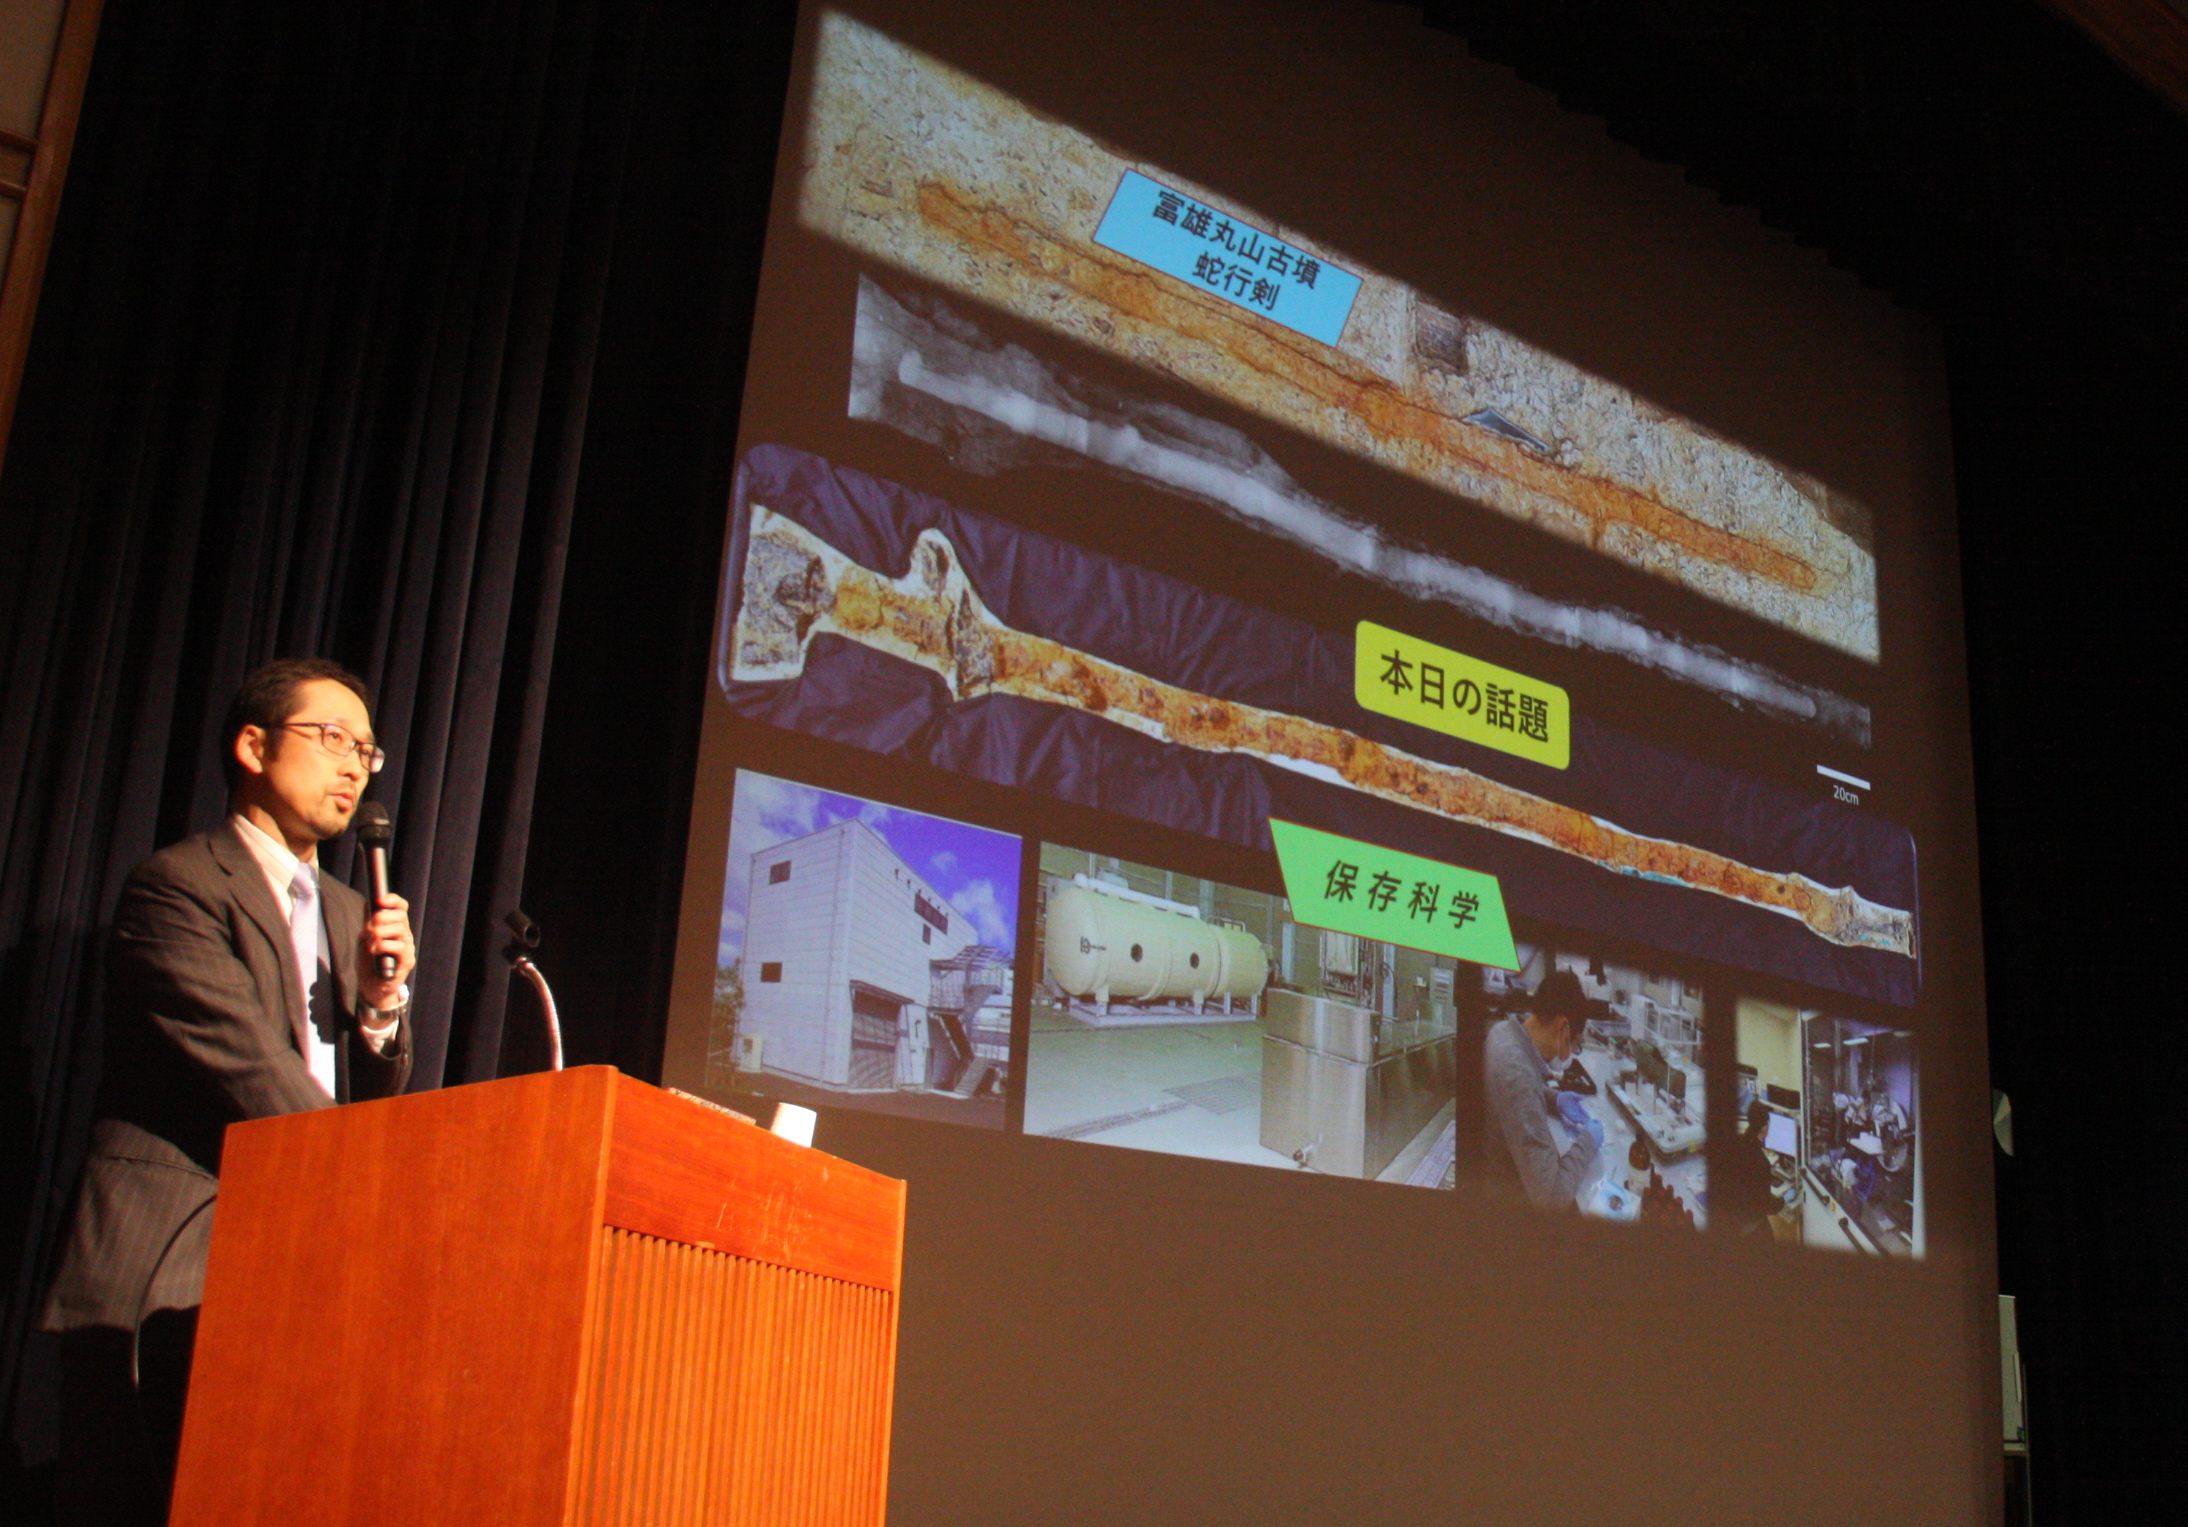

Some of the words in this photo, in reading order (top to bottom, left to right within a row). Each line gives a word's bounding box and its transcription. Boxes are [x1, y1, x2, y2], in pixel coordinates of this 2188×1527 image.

[1152, 190, 1321, 289] 富雄丸山古墳
[1192, 251, 1281, 311] 蛇行剣
[1380, 649, 1549, 743] 本日の話題
[1833, 785, 1859, 805] 20cm
[1324, 860, 1480, 929] 保存科学
